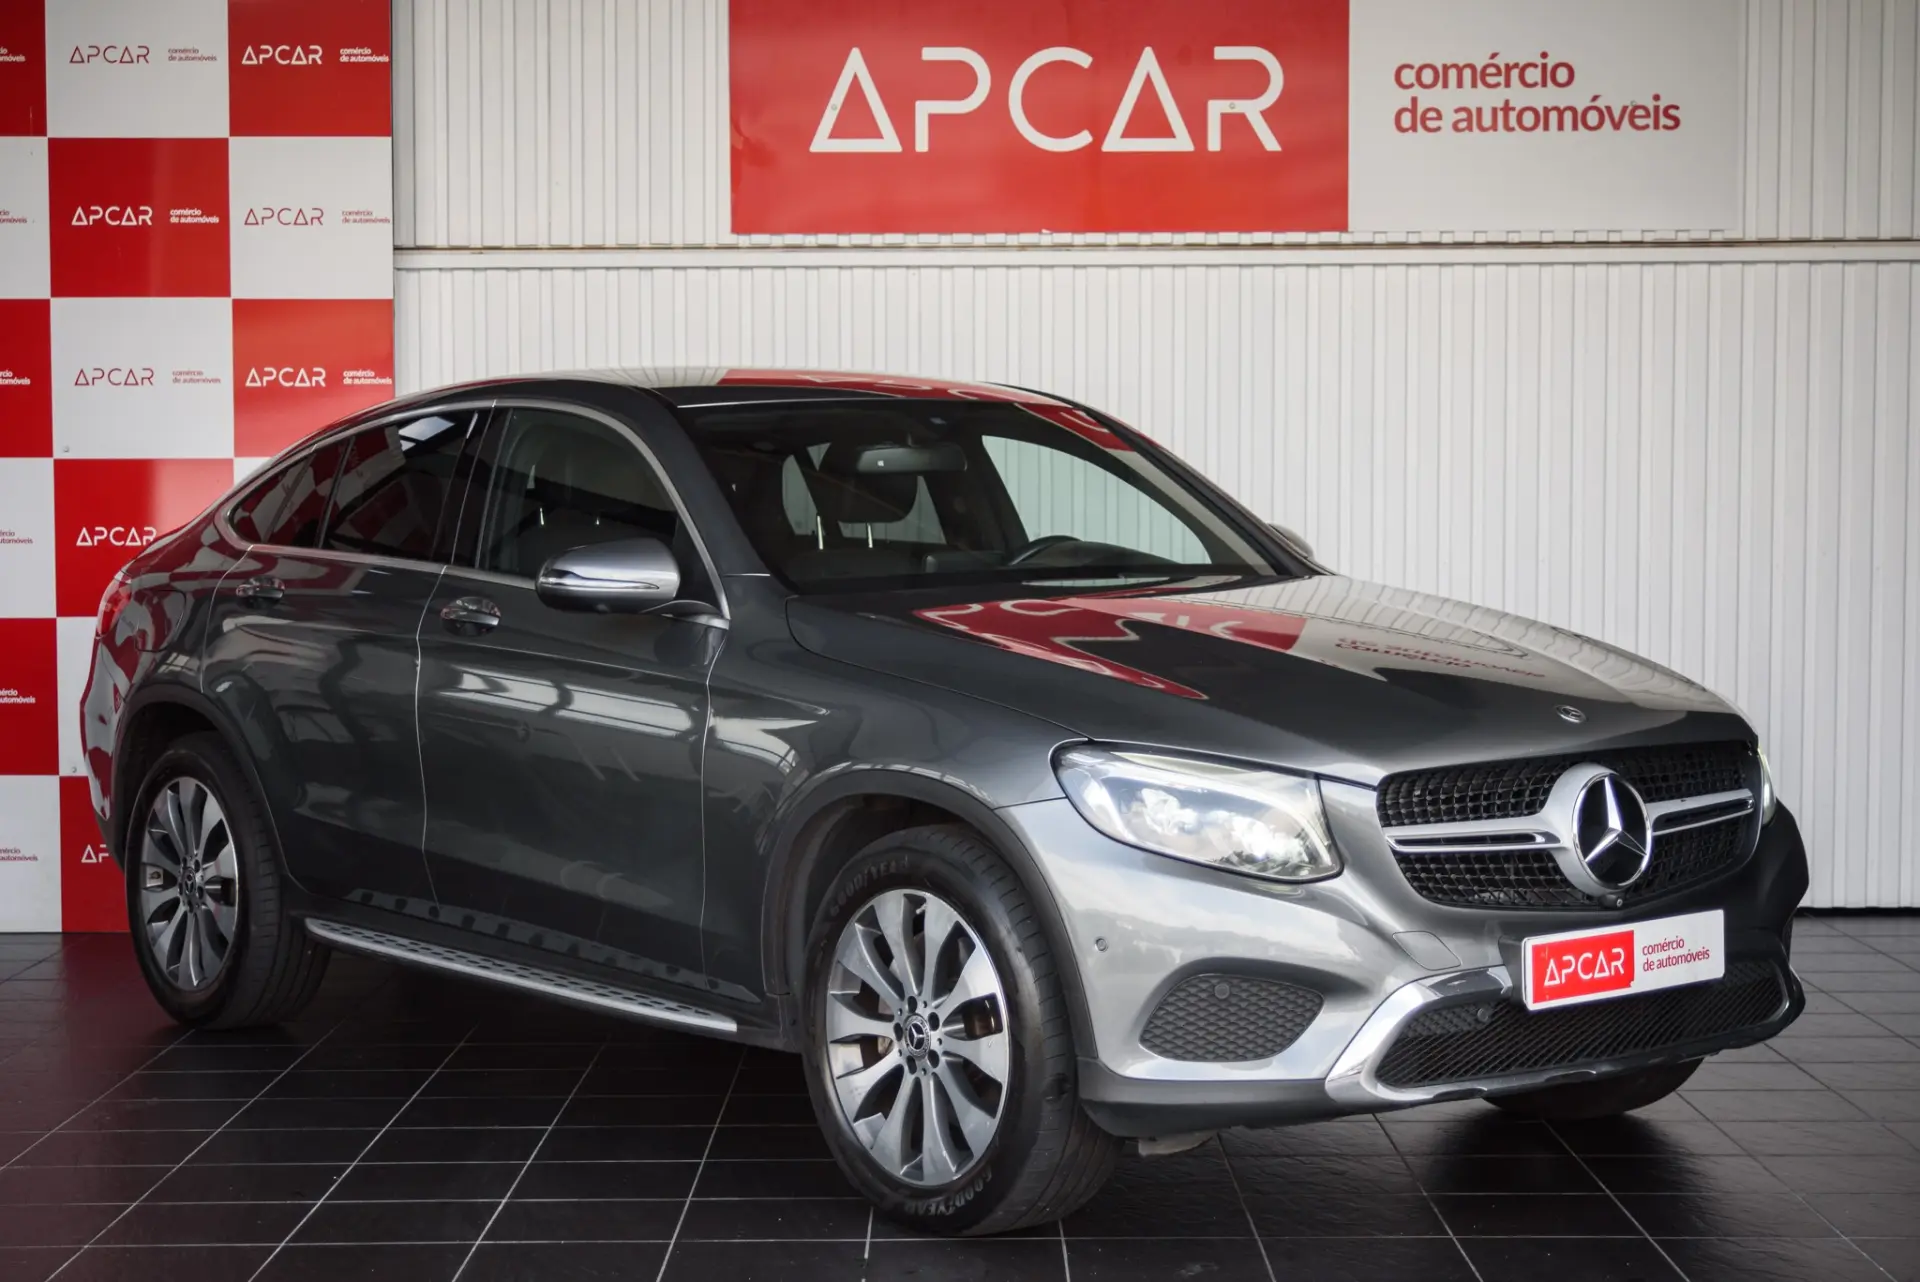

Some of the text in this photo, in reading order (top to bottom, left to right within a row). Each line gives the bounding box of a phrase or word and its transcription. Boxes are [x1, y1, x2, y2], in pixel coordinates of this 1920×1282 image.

[69, 45, 150, 64] APCAR
[241, 45, 323, 65] APCAR
[340, 54, 349, 62] de
[1394, 50, 1575, 90] comércio
[809, 46, 1284, 153] APCAR
[1394, 93, 1681, 133] de automóveis
[71, 206, 153, 226] APCAR
[170, 215, 179, 223] de
[244, 207, 324, 226] APCAR
[74, 368, 154, 387] APCAR
[245, 367, 327, 387] APCAR
[343, 377, 352, 385] de
[76, 526, 157, 547] APCAR
[1642, 935, 1685, 956] comércio
[1543, 947, 1625, 987] APCAR
[1643, 947, 1710, 972] de automóveis
